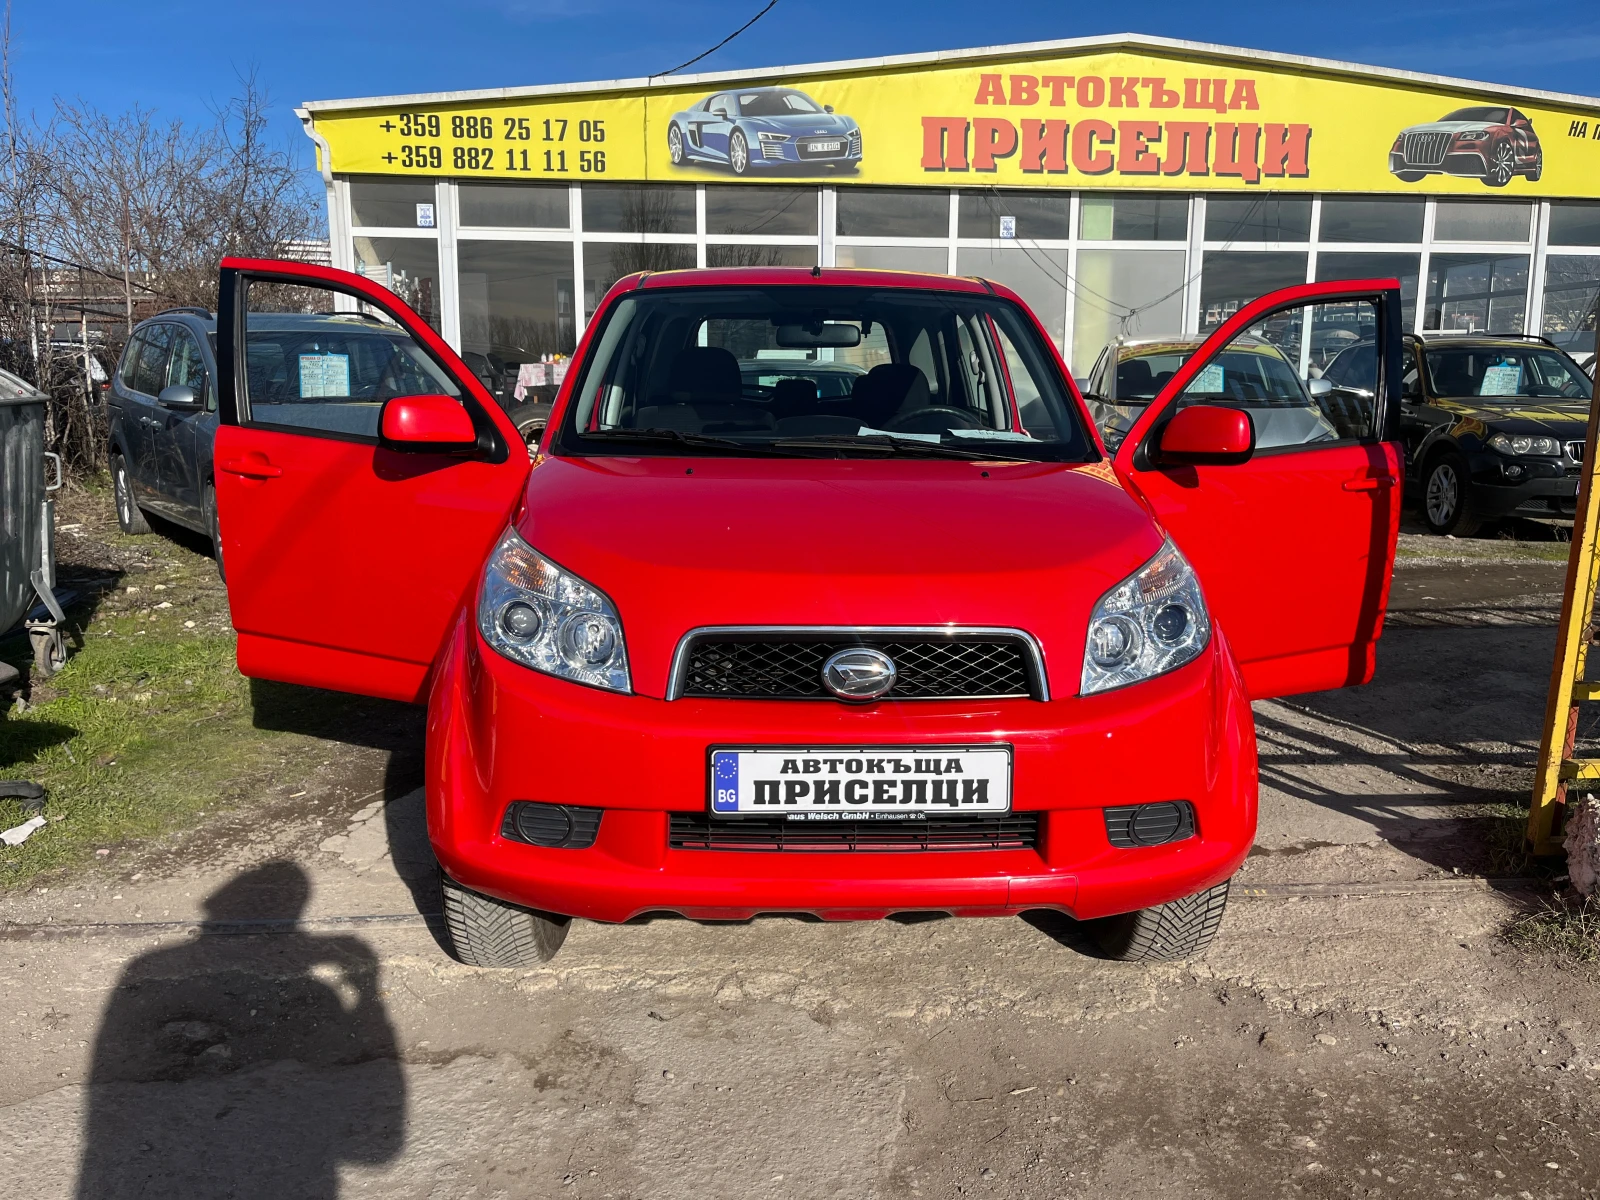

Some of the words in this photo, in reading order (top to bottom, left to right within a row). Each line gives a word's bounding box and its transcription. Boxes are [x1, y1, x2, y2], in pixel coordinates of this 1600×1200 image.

[974, 73, 1260, 114] АВТОКЪЩА
[379, 113, 441, 138] +359
[451, 115, 493, 139] 886
[503, 117, 531, 141] 25
[542, 118, 568, 142] 17
[578, 119, 606, 143] 05
[1567, 120, 1588, 139] НА
[381, 145, 442, 169] +359
[452, 146, 494, 171] 882
[505, 148, 531, 172] 11
[543, 149, 569, 172] 11
[579, 150, 606, 173] 56
[921, 116, 1312, 185] ПРИСЕЛЦИ
[780, 758, 963, 775] АВТОКЪЩА
[717, 788, 736, 803] BG
[753, 778, 990, 807] ПРИСЕЛЦИ
[787, 812, 805, 820] aus
[807, 812, 839, 820] Welsch
[841, 811, 870, 820] GmbH
[875, 812, 908, 820] Einhausen
